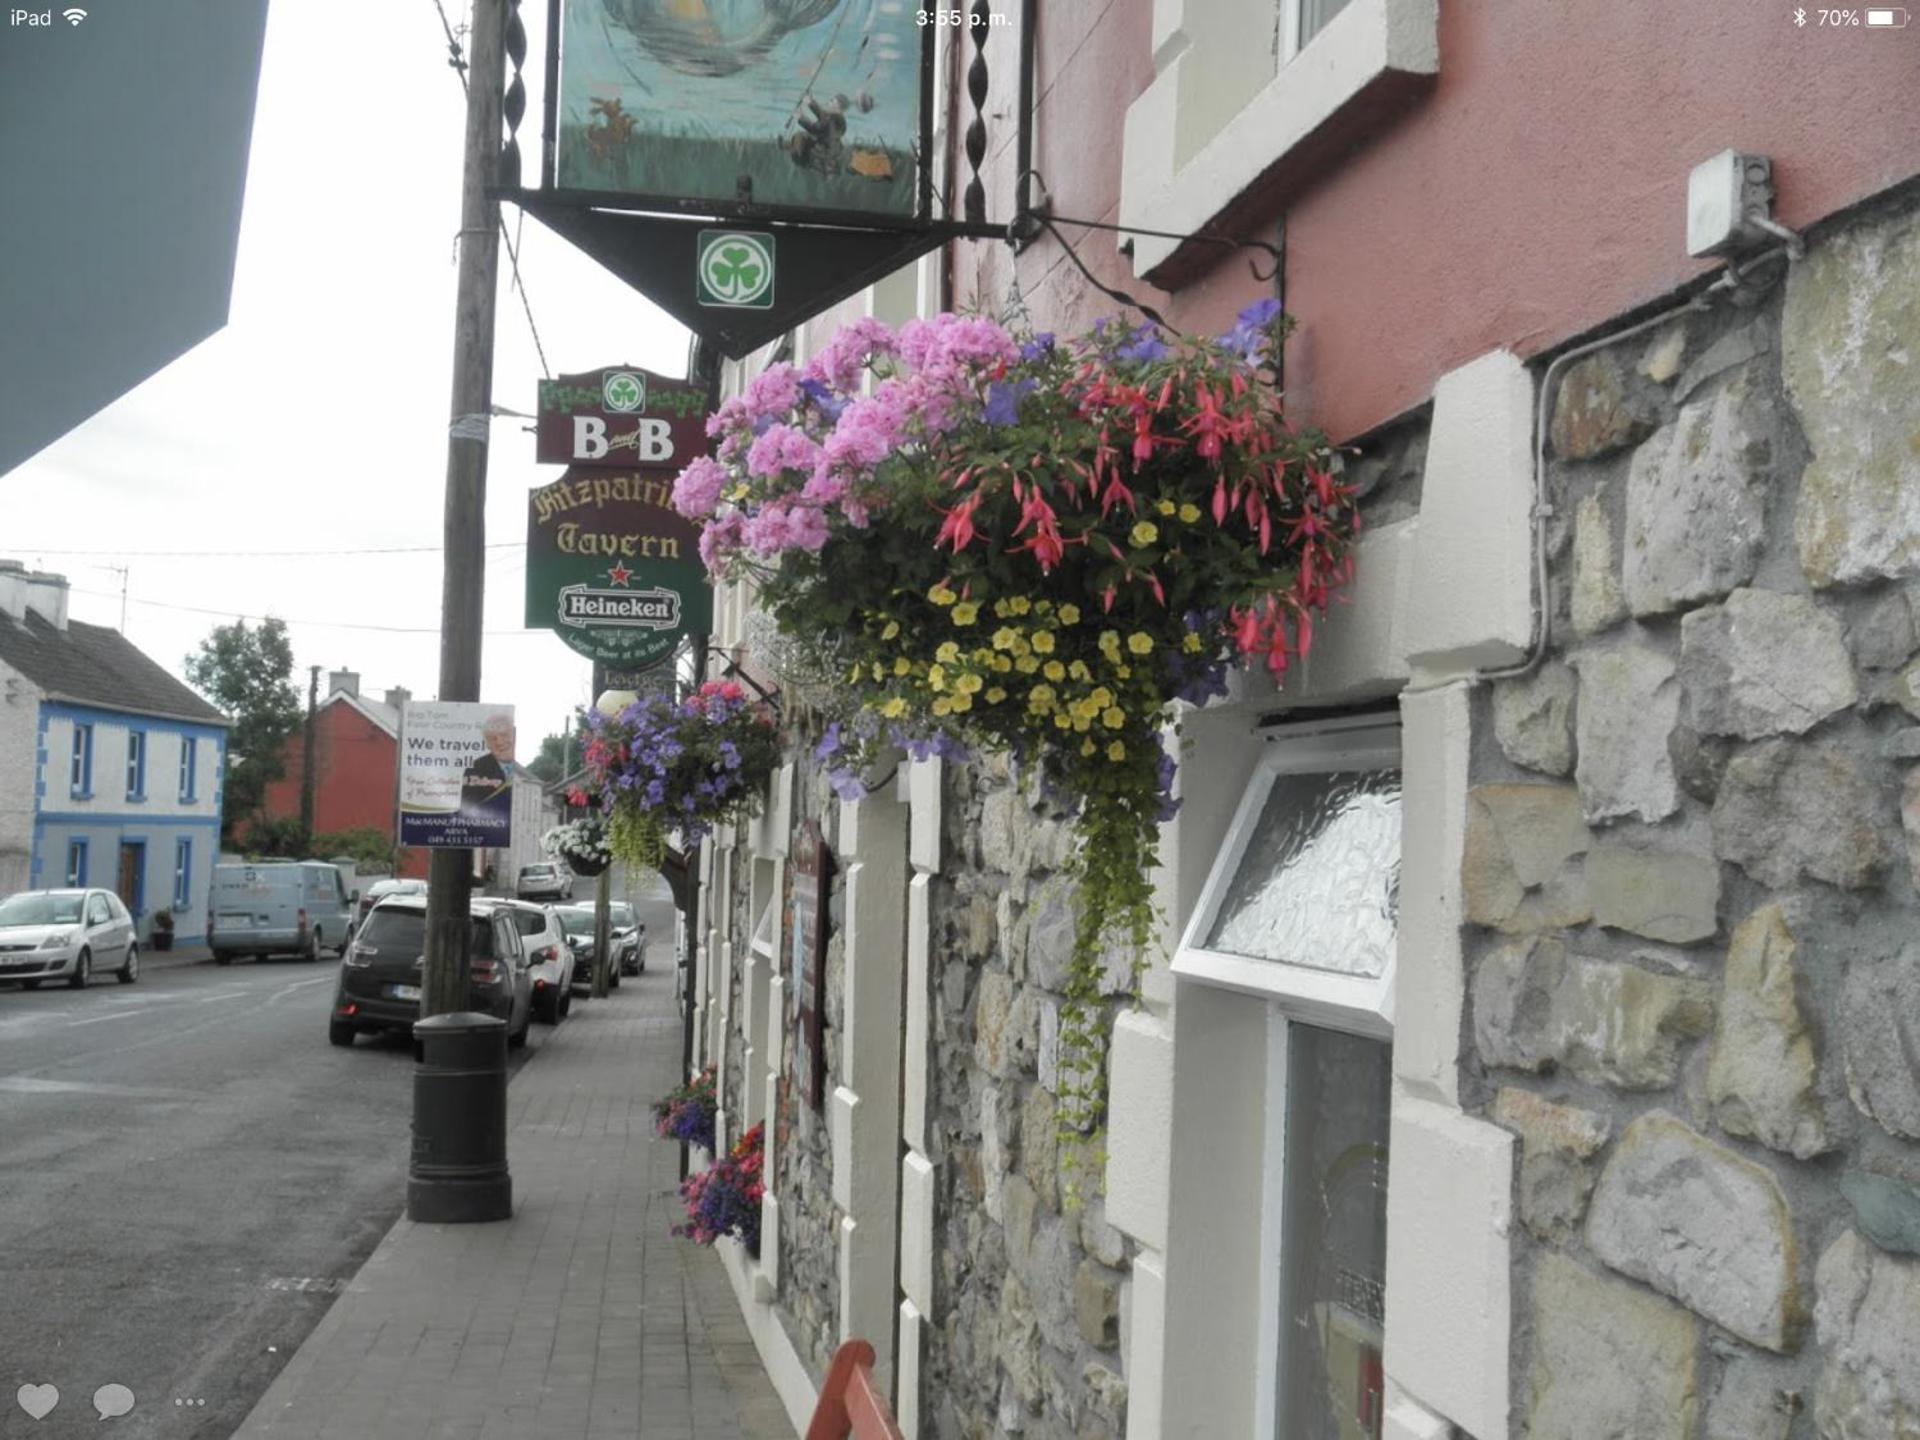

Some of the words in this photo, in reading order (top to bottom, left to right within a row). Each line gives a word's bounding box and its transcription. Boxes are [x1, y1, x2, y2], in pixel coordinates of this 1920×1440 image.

[573, 415, 609, 459] B
[638, 417, 675, 461] B
[532, 472, 674, 525] Fitzpatri
[557, 522, 680, 560] Tavern
[570, 595, 669, 618] Heineken
[407, 737, 435, 750] We
[439, 739, 486, 751] travel
[406, 754, 449, 767] them
[454, 755, 474, 768] all
